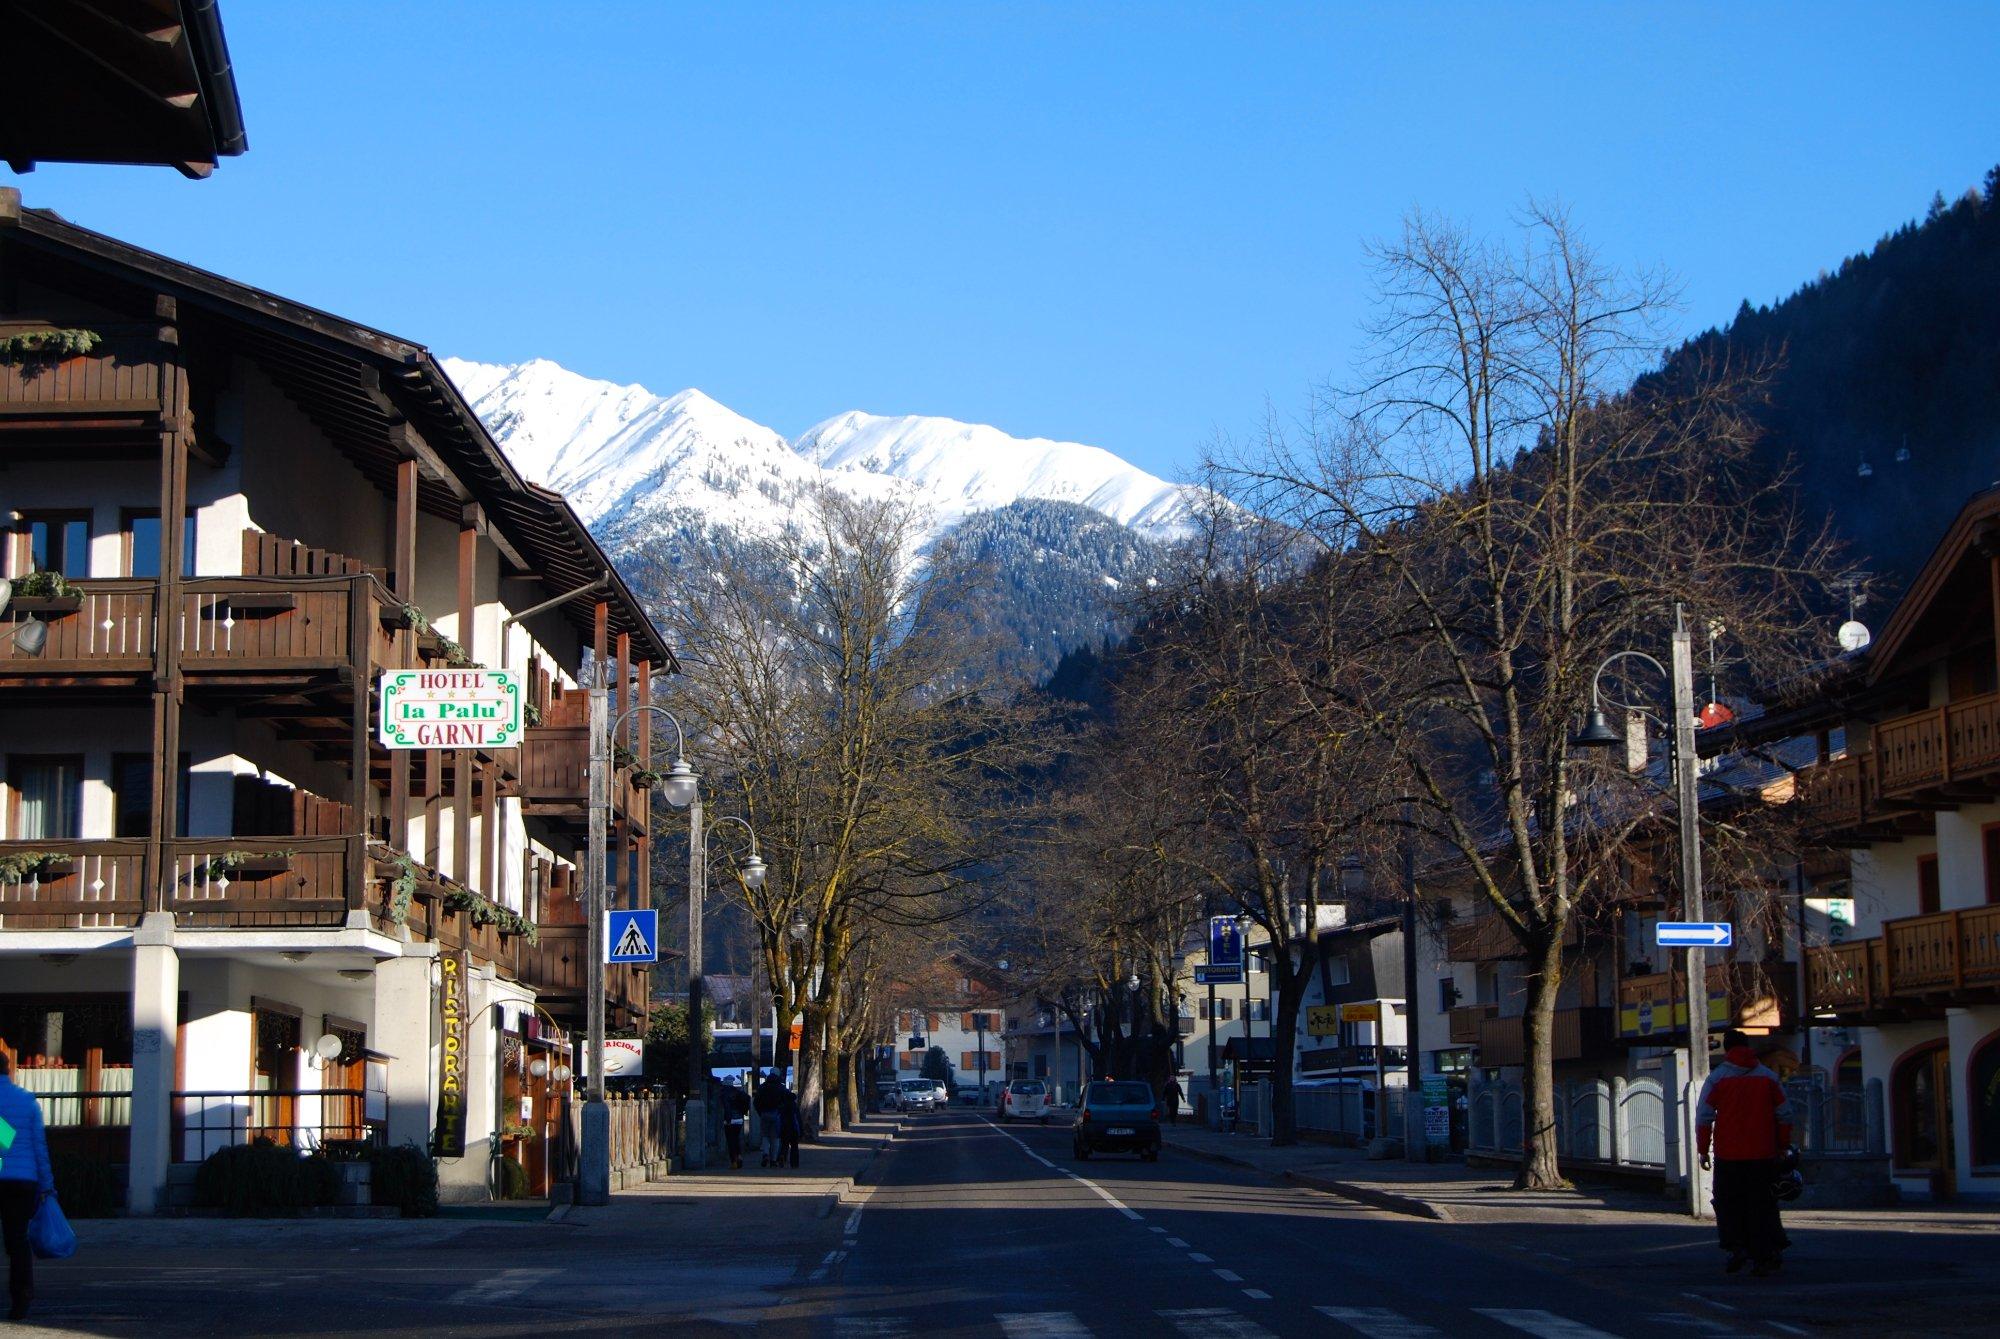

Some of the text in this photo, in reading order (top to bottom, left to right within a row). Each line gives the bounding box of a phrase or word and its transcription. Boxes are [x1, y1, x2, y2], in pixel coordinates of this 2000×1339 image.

[420, 673, 485, 689] HOTEL
[402, 703, 425, 719] la
[417, 723, 484, 745] GARNI
[442, 958, 461, 1150] RISTORANTE
